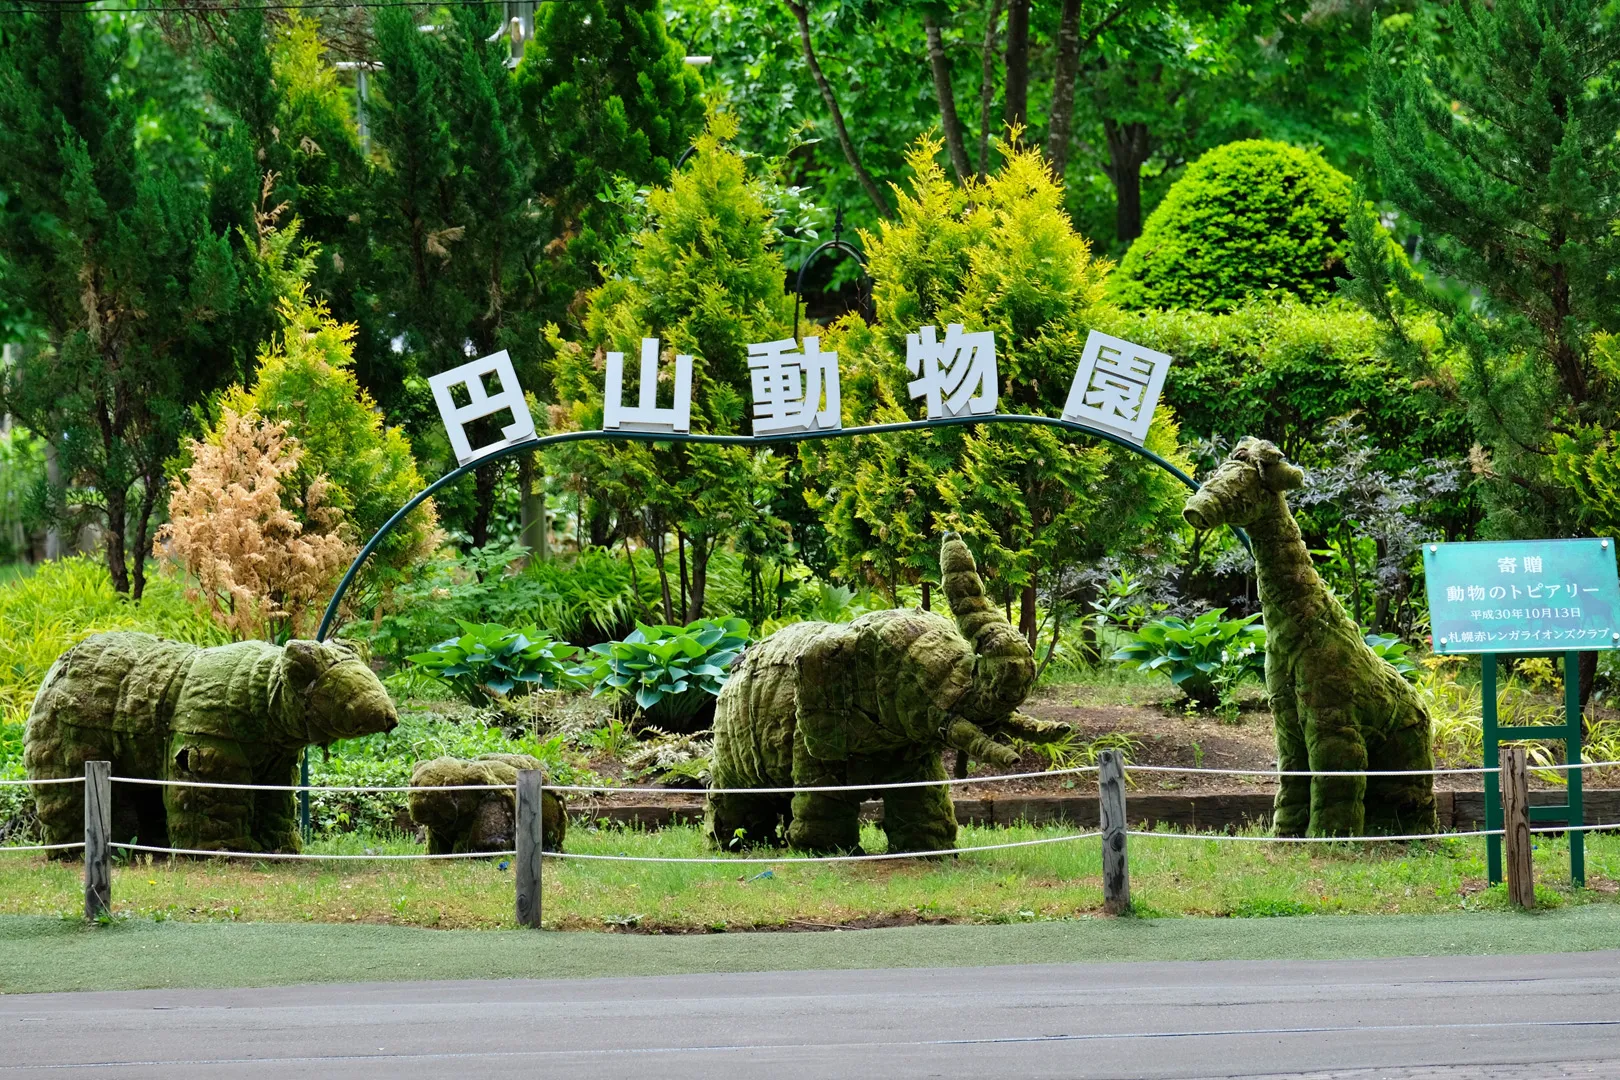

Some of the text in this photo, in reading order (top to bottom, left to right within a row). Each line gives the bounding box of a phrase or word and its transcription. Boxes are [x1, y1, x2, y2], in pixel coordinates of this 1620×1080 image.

[428, 323, 1172, 467] 円山動物園
[1497, 555, 1543, 574] 寄贈
[1446, 583, 1600, 602] 動物のトピアリー
[1470, 607, 1581, 620] 平成30年10月13日
[1448, 627, 1610, 643] 札幌赤レンガライオンズクラブ
